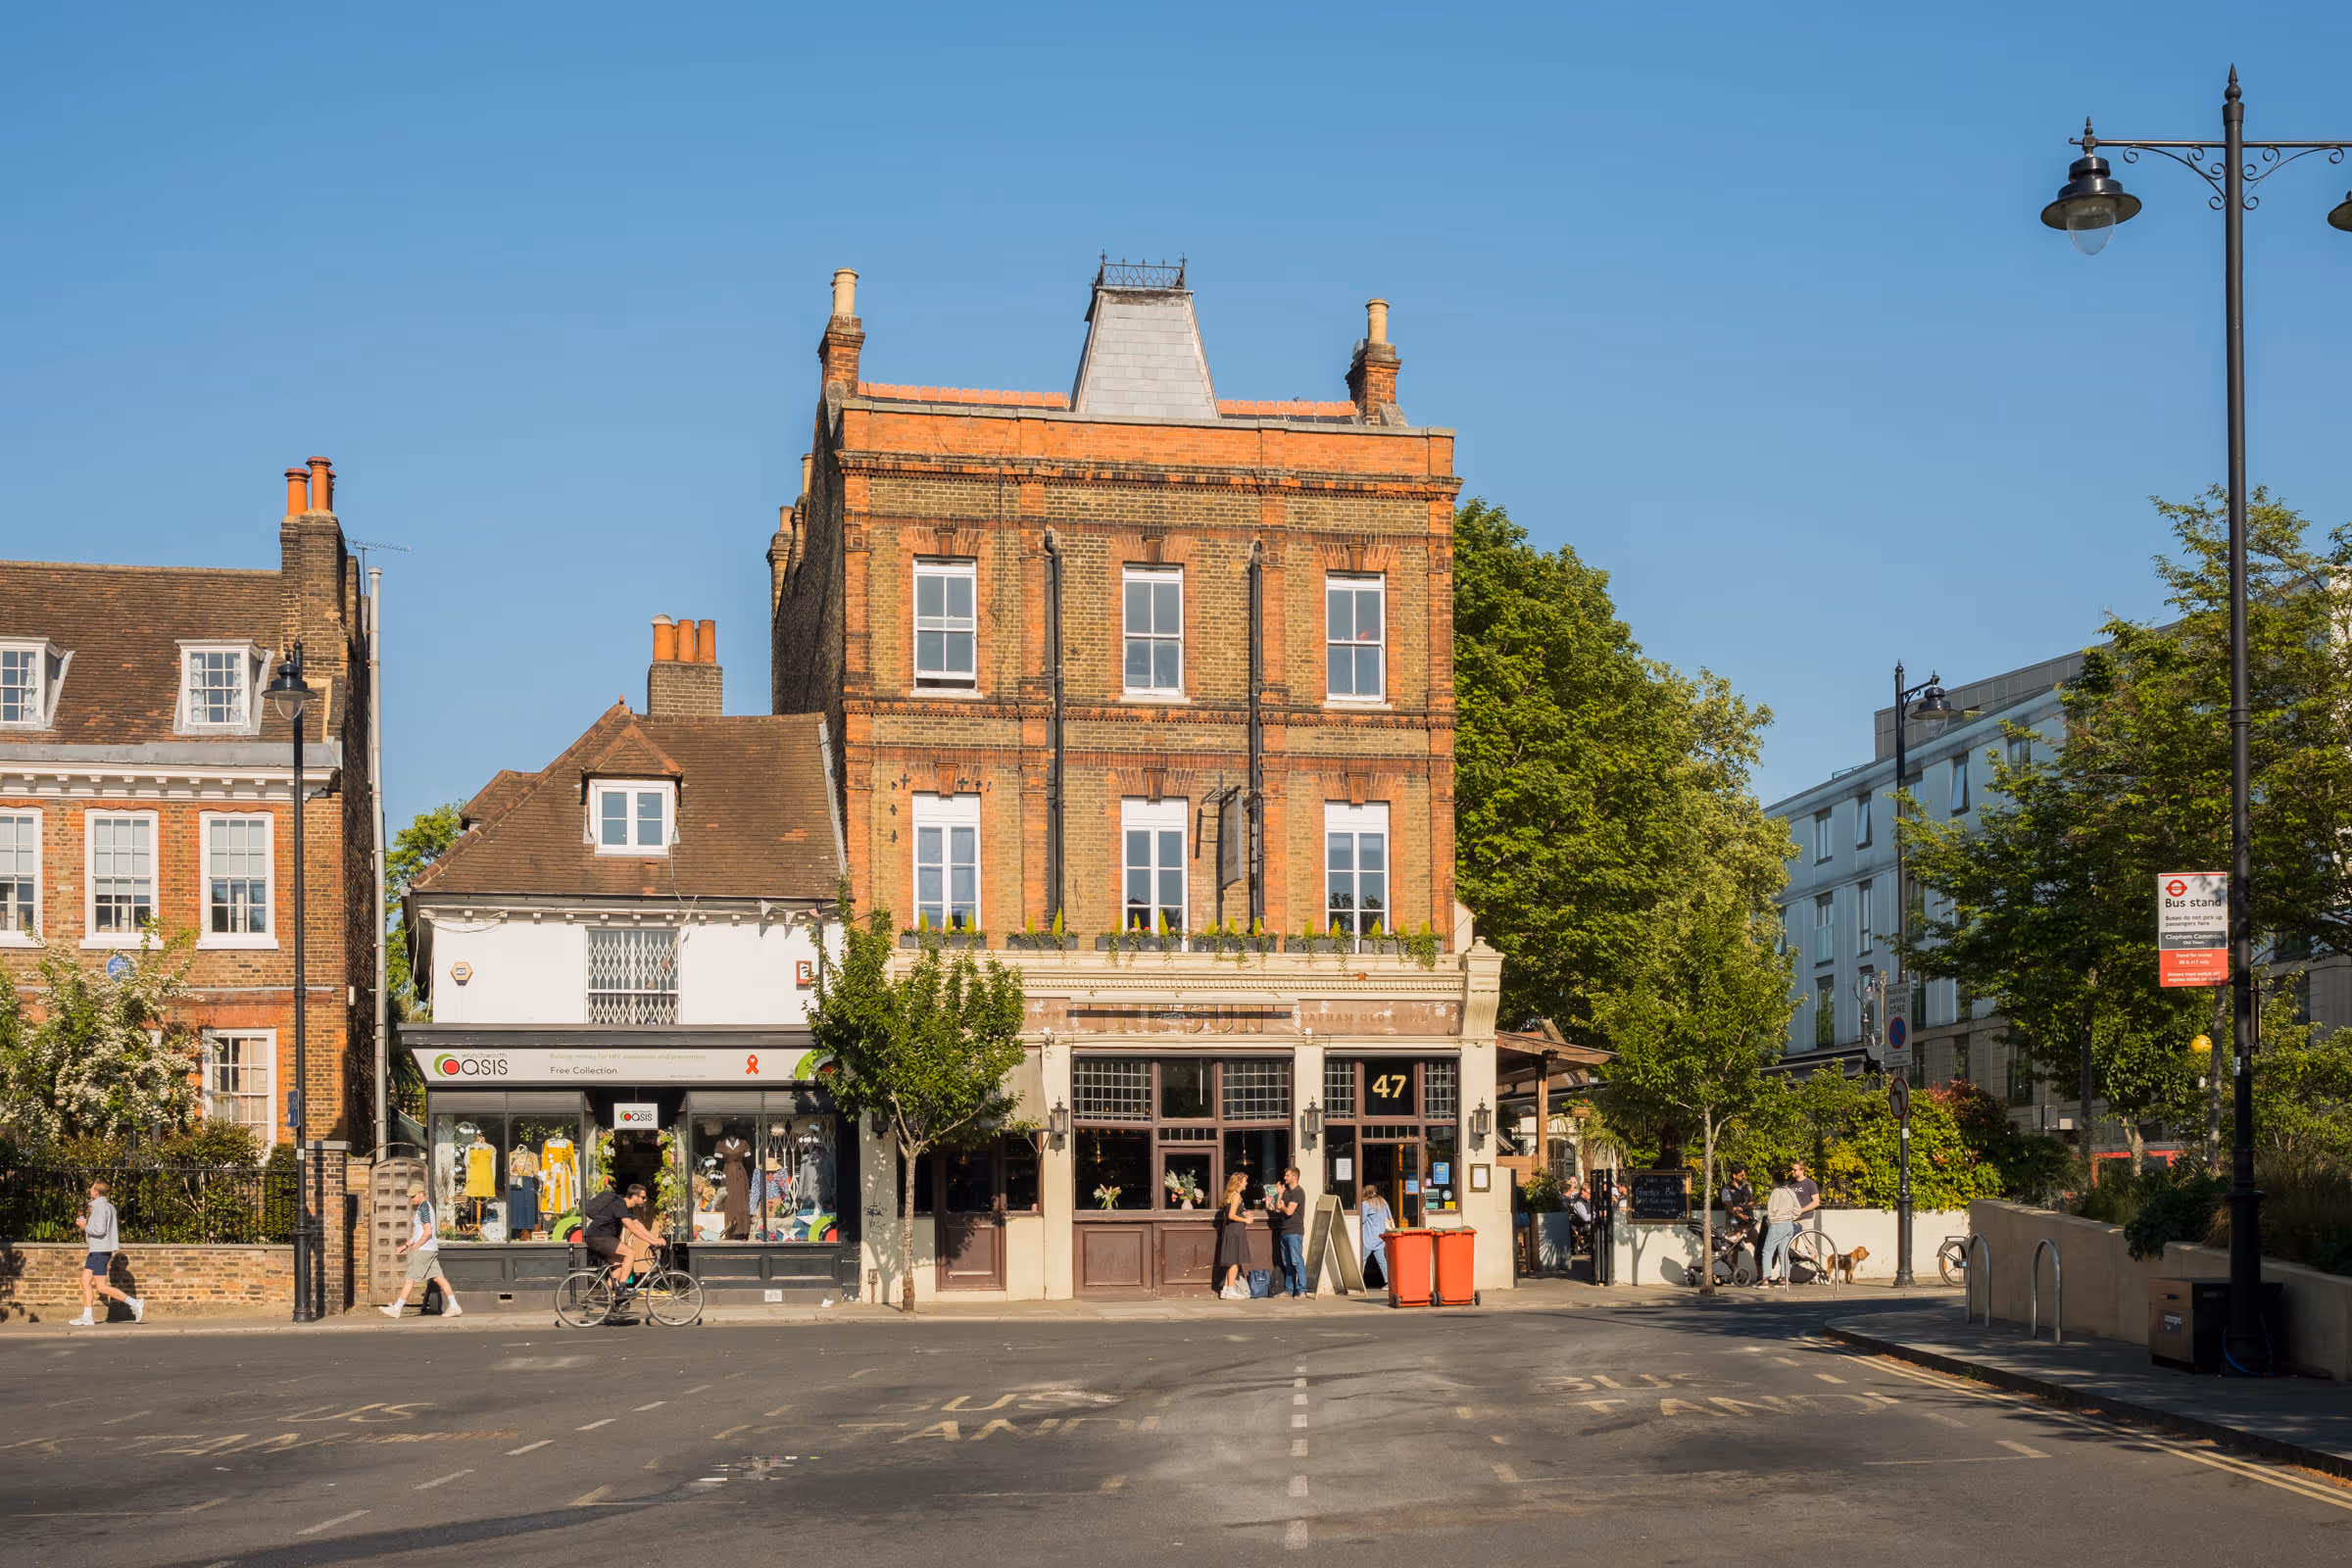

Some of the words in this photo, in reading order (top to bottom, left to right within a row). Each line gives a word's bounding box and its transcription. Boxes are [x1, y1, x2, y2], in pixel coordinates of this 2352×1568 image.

[2165, 898, 2186, 907] Bus
[2189, 897, 2222, 907] stand
[1888, 1004, 1906, 1014] ZONE
[572, 1066, 617, 1075] Collection
[1372, 1074, 1407, 1098] 47
